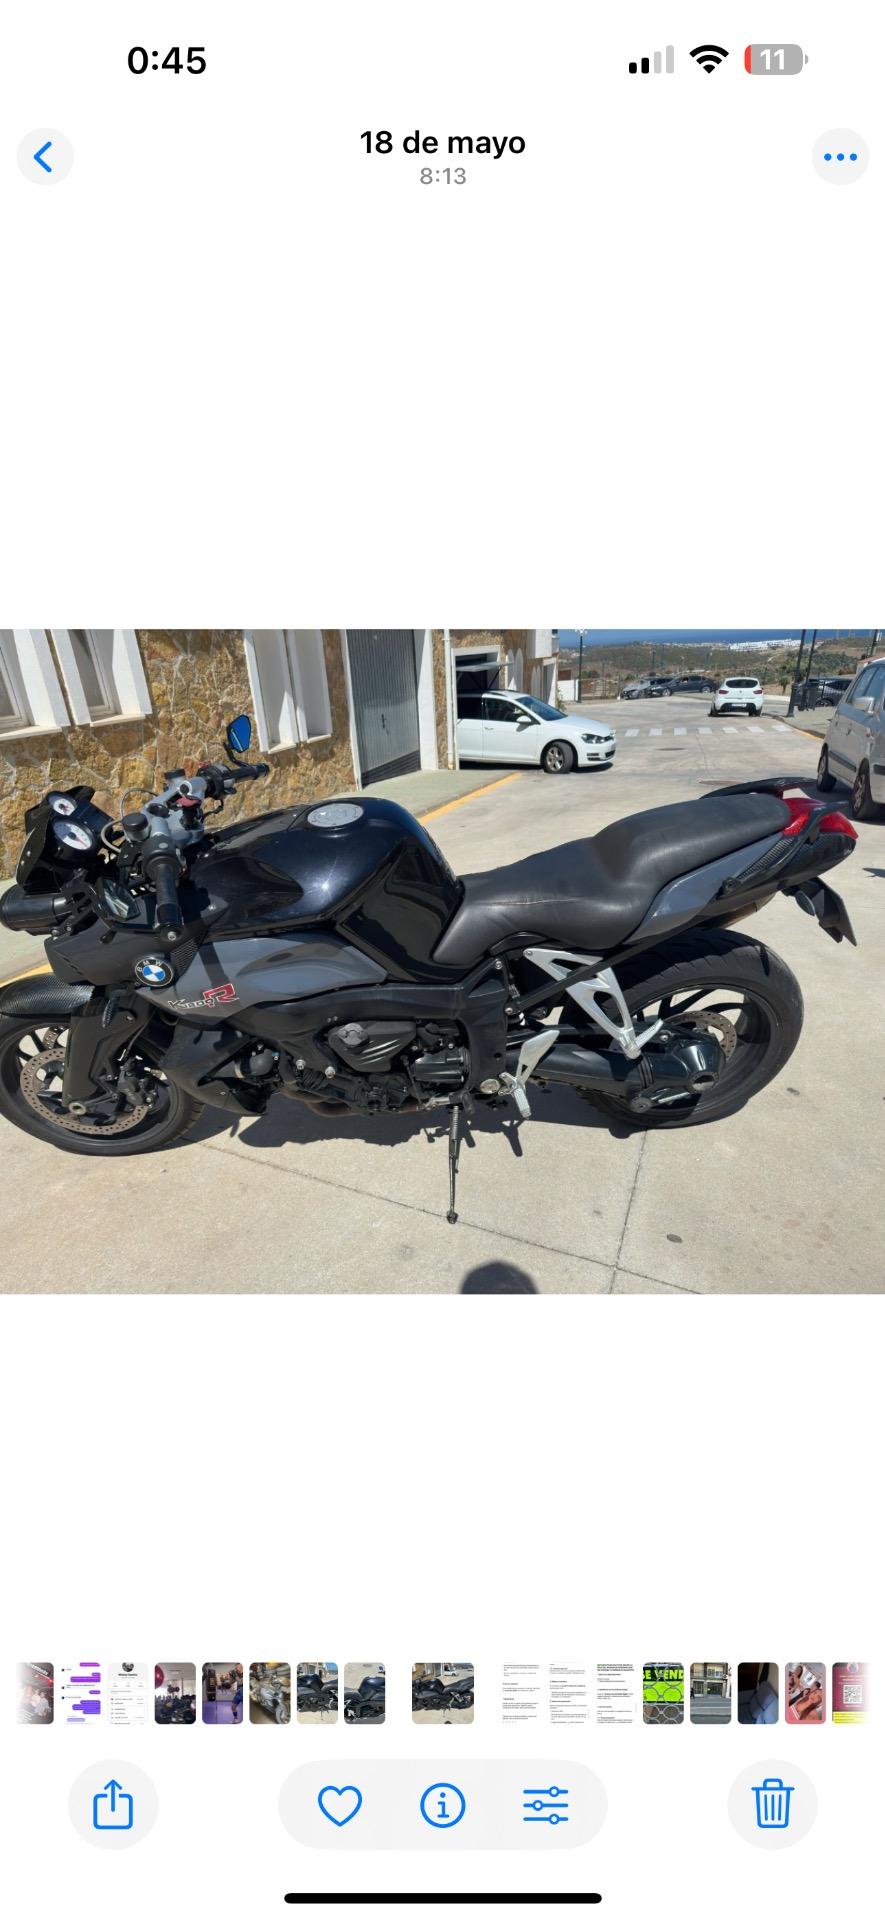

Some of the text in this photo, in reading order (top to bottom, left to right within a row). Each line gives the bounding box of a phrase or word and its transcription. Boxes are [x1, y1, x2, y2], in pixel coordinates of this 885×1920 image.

[127, 46, 207, 75] 0:45
[760, 48, 785, 70] 11
[360, 129, 526, 160] 18 de mayo
[419, 167, 467, 185] 8:13
